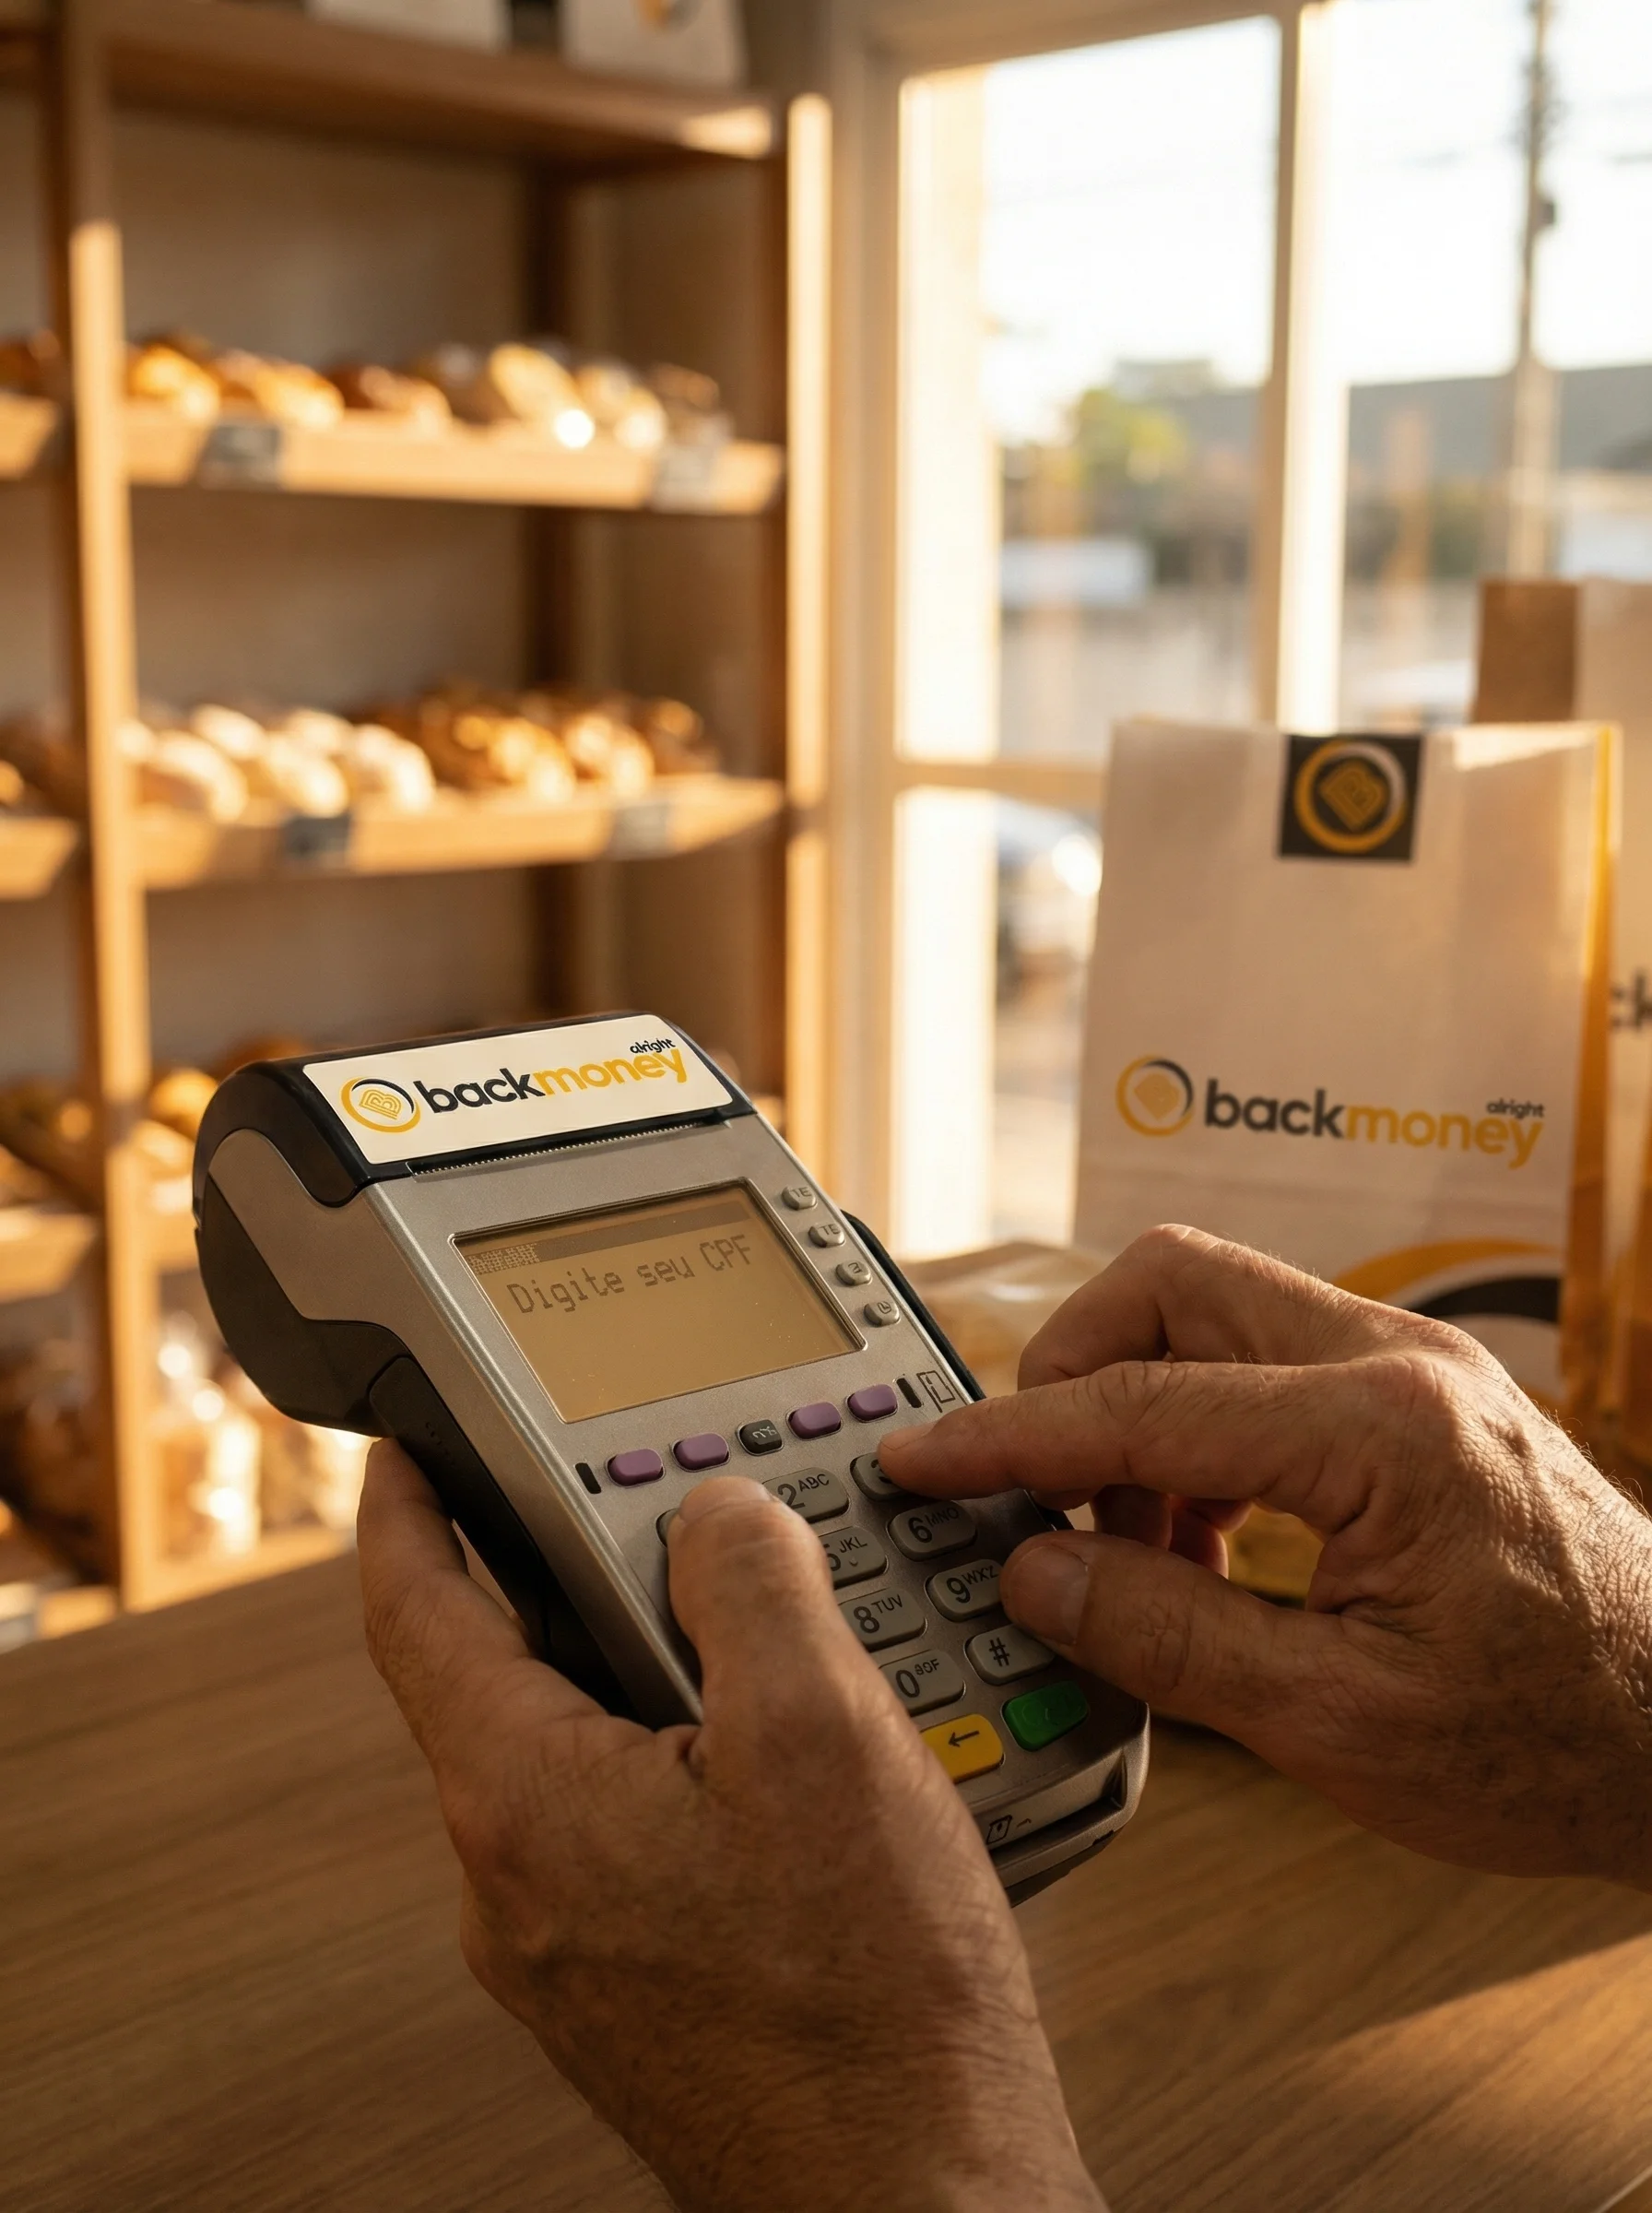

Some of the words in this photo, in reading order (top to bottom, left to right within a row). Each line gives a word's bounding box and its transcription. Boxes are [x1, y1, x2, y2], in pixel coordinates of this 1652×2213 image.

[630, 1038, 676, 1053] alright
[413, 1048, 688, 1114] backmoney
[1487, 1099, 1545, 1119] alright
[1204, 1077, 1544, 1169] backmoney
[506, 1268, 624, 1314] Digite
[636, 1255, 694, 1287] seu
[699, 1234, 752, 1272] CPF
[777, 1483, 806, 1509] 2
[908, 1517, 933, 1544] 6
[946, 1577, 971, 1604] 9
[853, 1606, 880, 1634] 8
[871, 1594, 903, 1614] TUV
